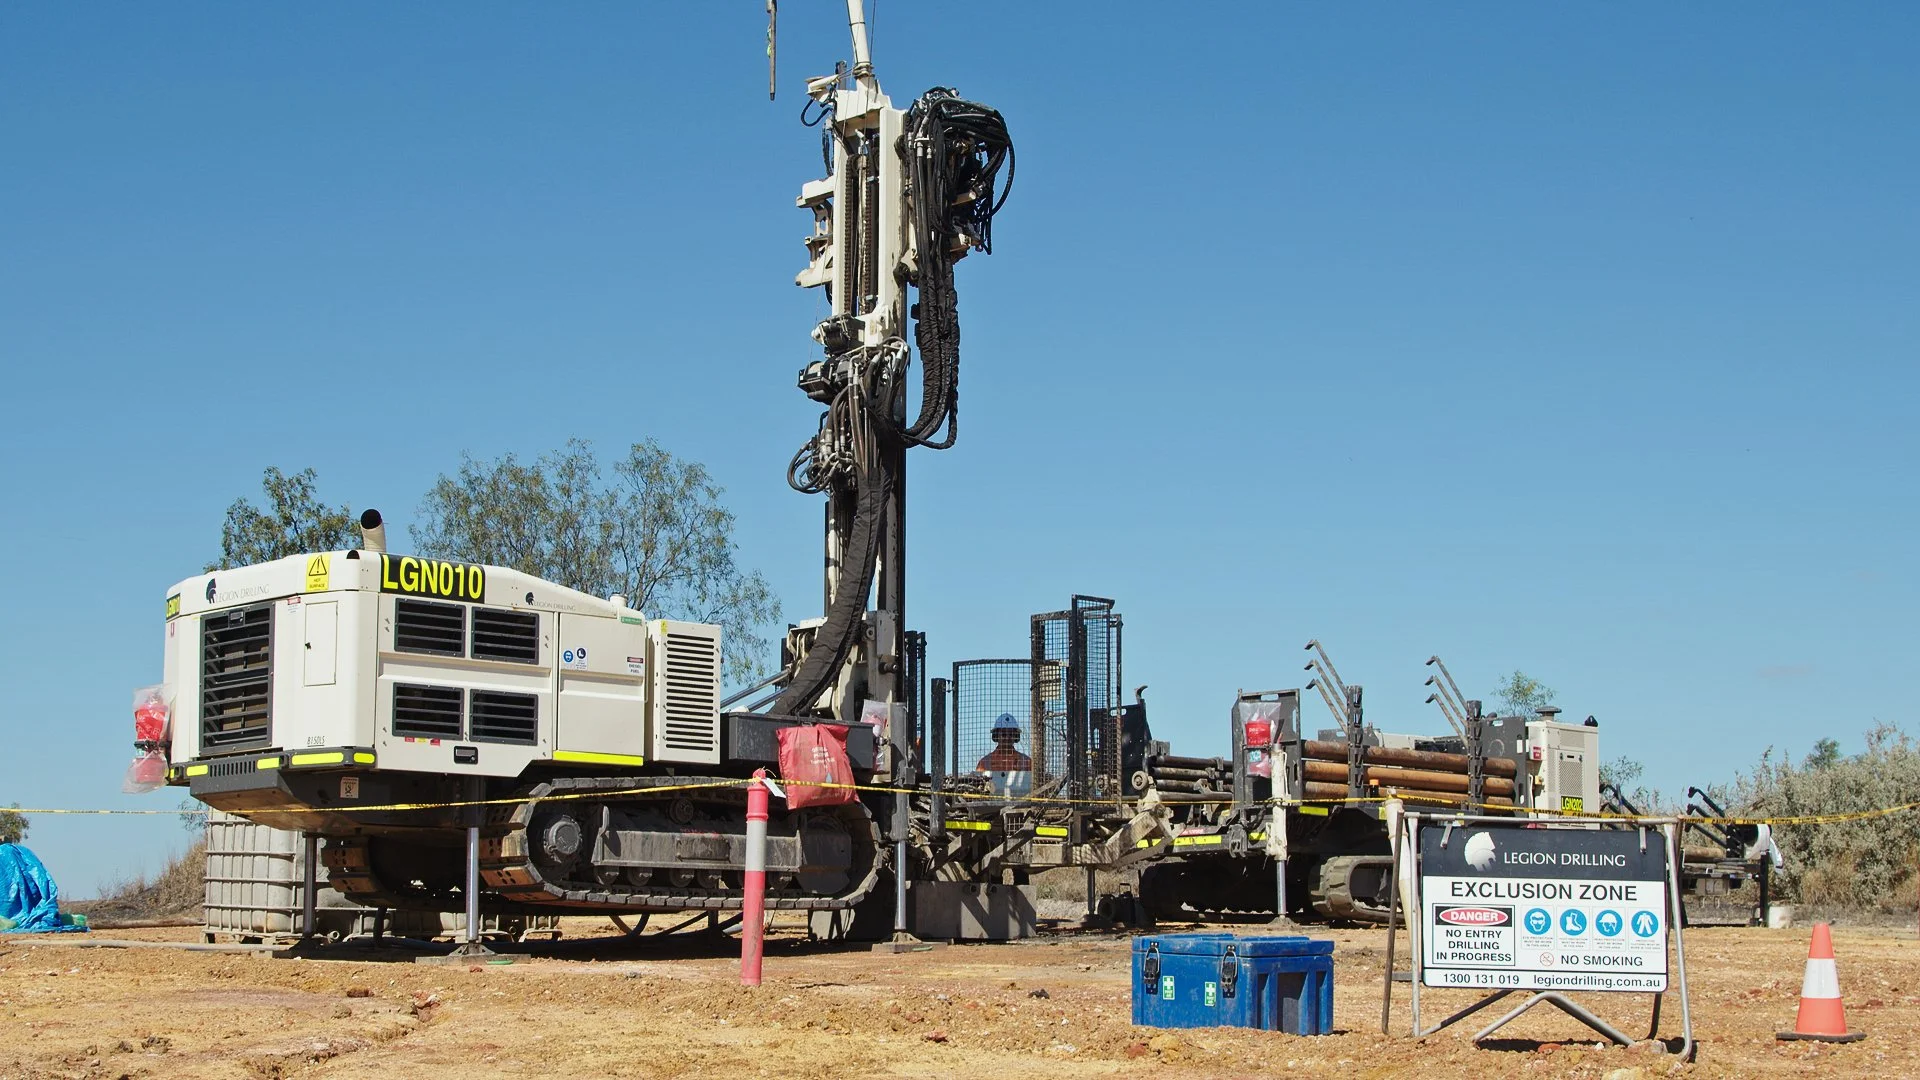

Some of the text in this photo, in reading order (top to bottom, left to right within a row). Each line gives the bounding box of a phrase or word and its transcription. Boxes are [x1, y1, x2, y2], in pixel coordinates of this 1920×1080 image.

[382, 554, 483, 600] LGN010
[1561, 796, 1583, 811] LGN202
[1533, 808, 1564, 816] CAUTION
[1504, 852, 1626, 867] LEGION DRILLING
[1451, 881, 1638, 901] EXCLUSION ZONE
[1450, 911, 1499, 922] DANGER
[1446, 929, 1502, 938] NO ENTRY
[1448, 940, 1500, 950] DRILLING
[1436, 952, 1512, 962] IN PROGRESS
[1561, 955, 1643, 967] NO SMOKING
[1444, 973, 1520, 985] 1300 131 019
[1533, 974, 1661, 989] legiondrilling.com.au
